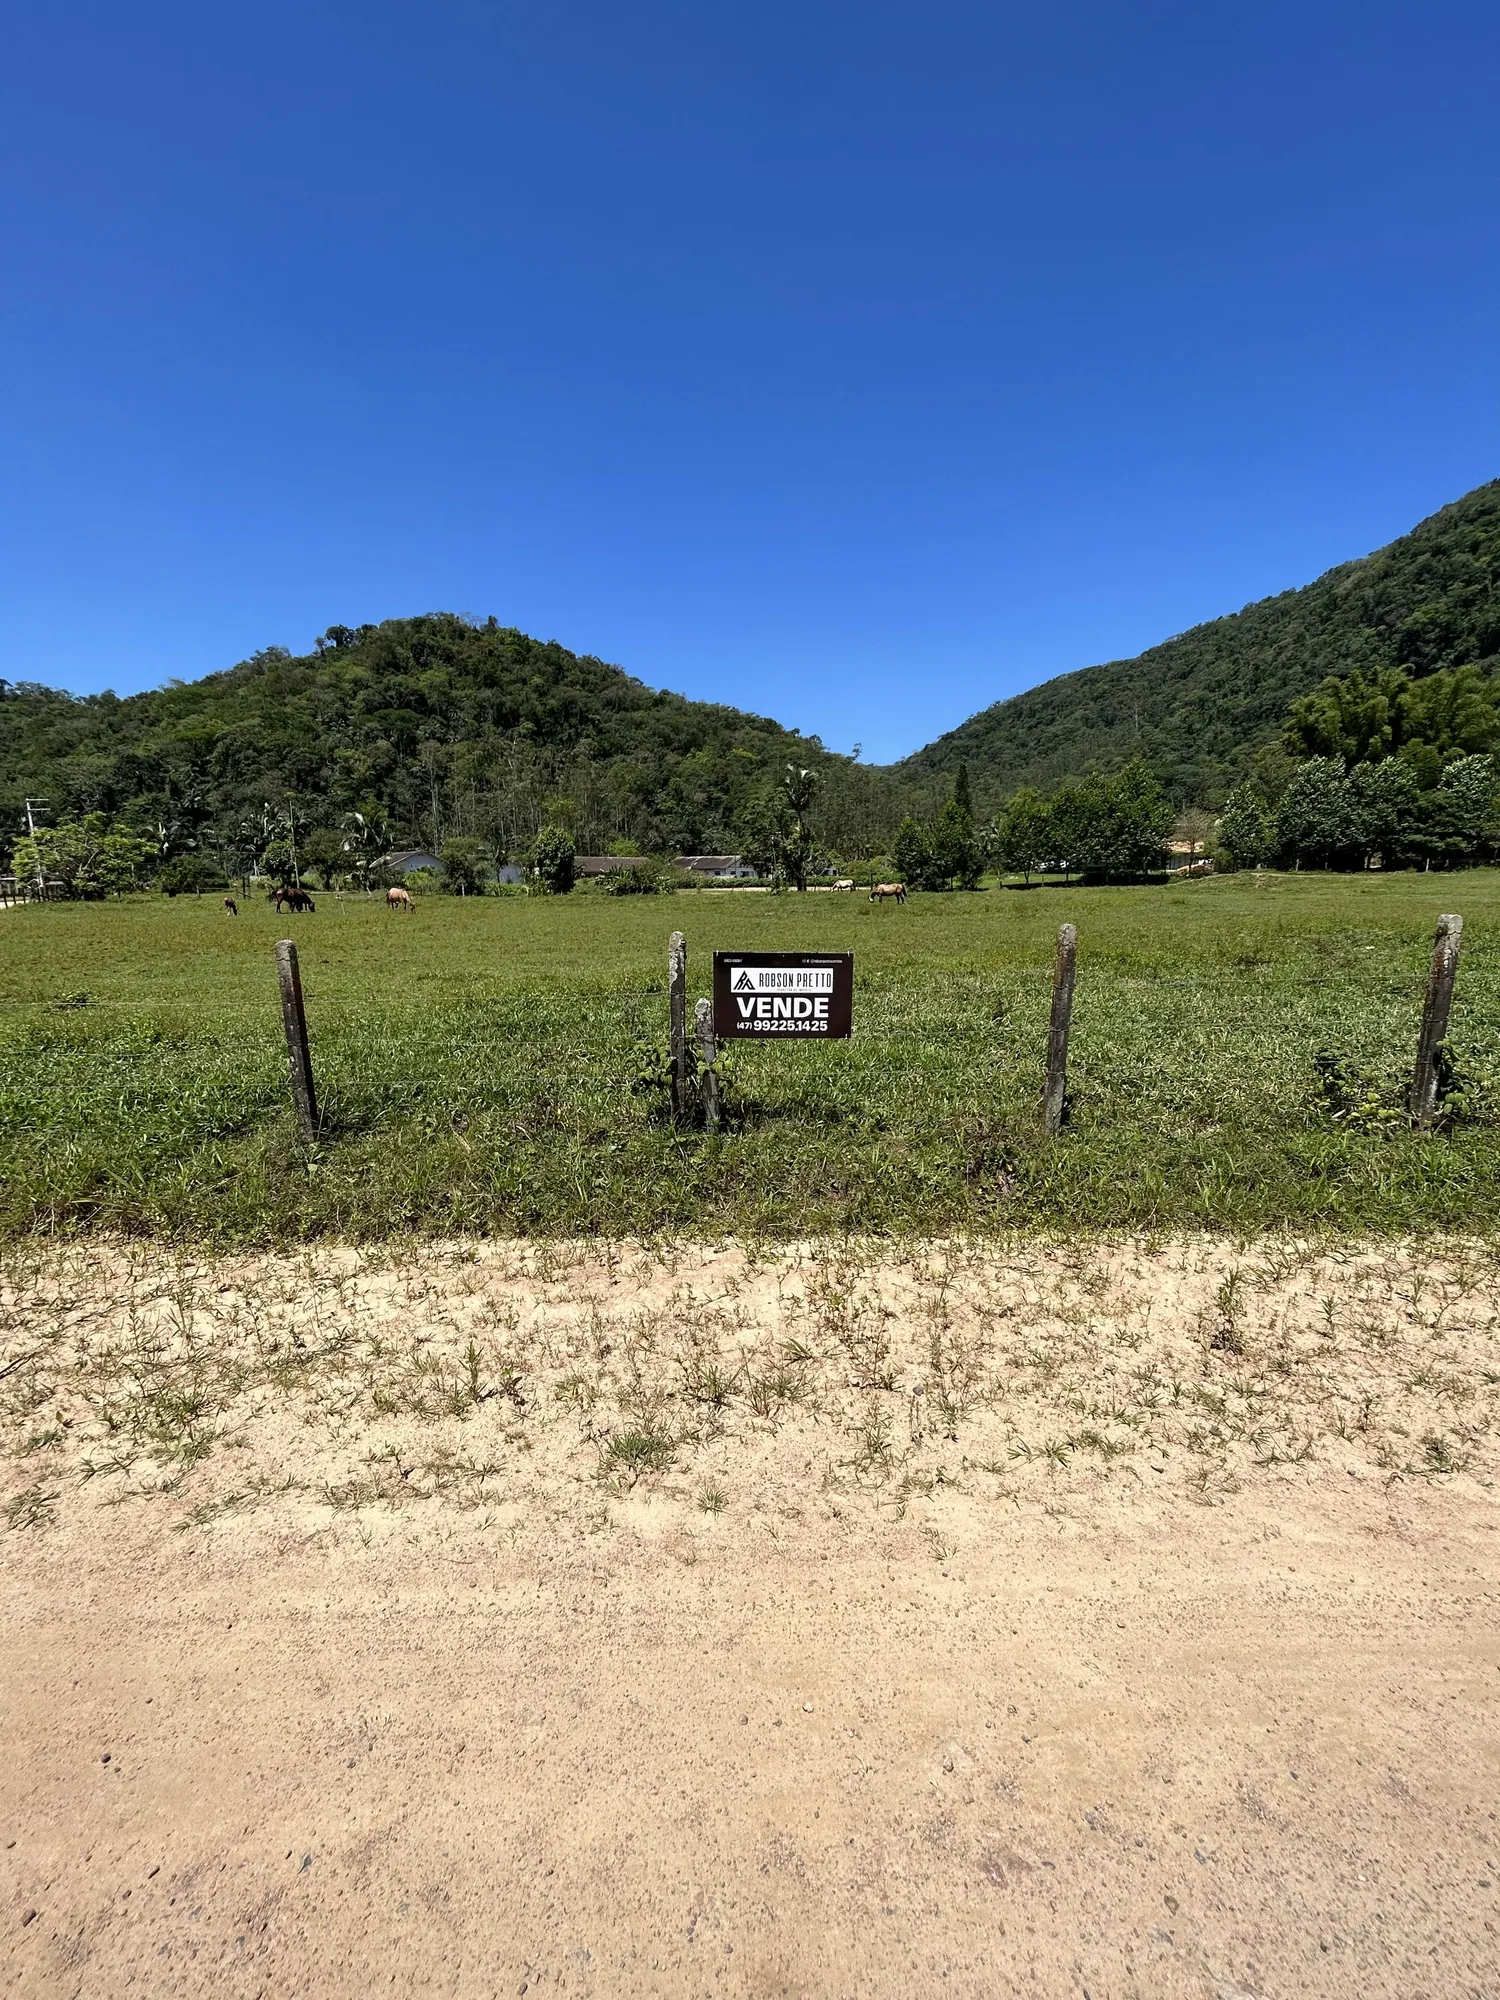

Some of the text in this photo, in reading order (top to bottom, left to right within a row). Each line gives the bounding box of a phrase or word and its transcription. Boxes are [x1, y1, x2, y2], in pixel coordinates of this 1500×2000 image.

[759, 973, 832, 988] ROBSON PRETTO
[736, 997, 829, 1018] VENDE
[736, 1020, 828, 1031] (47) 99225.1425
